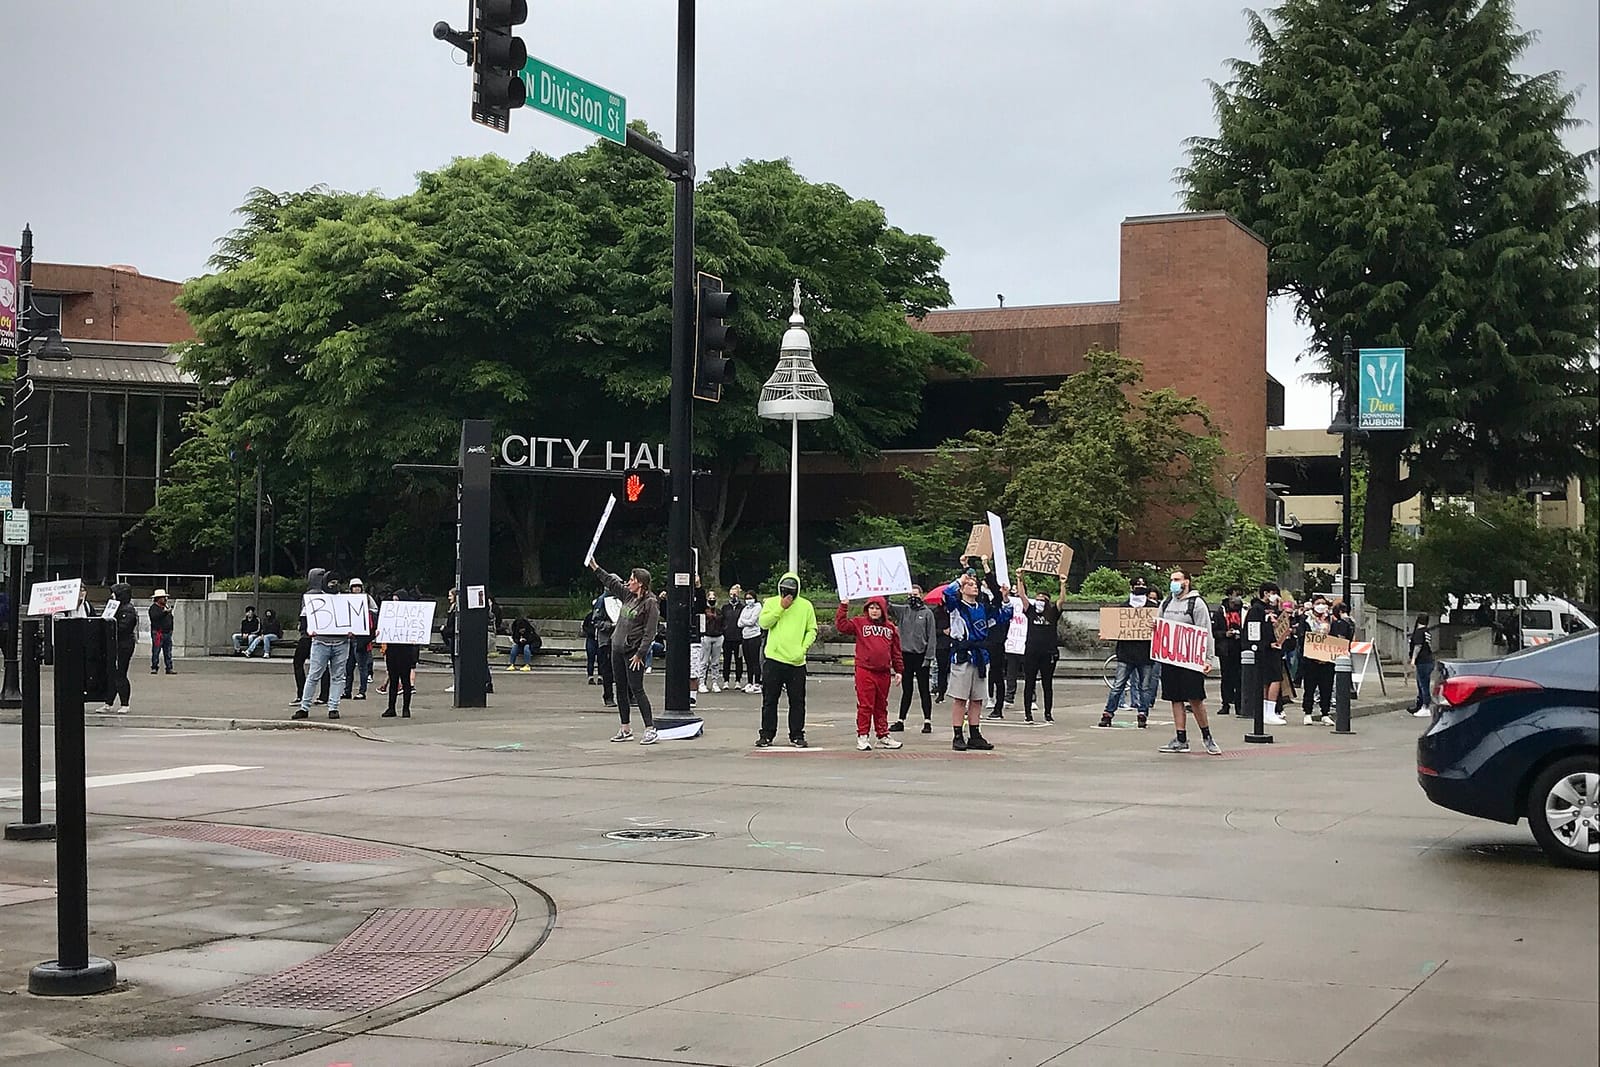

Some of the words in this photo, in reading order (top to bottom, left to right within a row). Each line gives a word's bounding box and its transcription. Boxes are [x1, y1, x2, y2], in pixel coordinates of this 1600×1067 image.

[525, 72, 535, 99] N
[540, 71, 603, 127] Division
[607, 108, 620, 134] St
[1367, 397, 1395, 413] Dine
[501, 434, 590, 469] CITY
[605, 441, 671, 474] HAL
[6, 511, 13, 520] 2
[1028, 540, 1064, 554] BLACK
[1026, 550, 1061, 565] LIVES
[1022, 560, 1058, 574] MATTER
[841, 556, 907, 597] BLM
[306, 597, 366, 632] BLM
[383, 602, 425, 619] BLACK
[1119, 608, 1153, 620] BLACK
[394, 617, 425, 630] LIVES
[1119, 618, 1154, 629] LIVES
[380, 627, 425, 643] MATTER
[1117, 628, 1153, 639] MATTER
[1306, 633, 1328, 644] STOP
[1151, 619, 1171, 660] NO
[1168, 623, 1208, 667] JUSTICE
